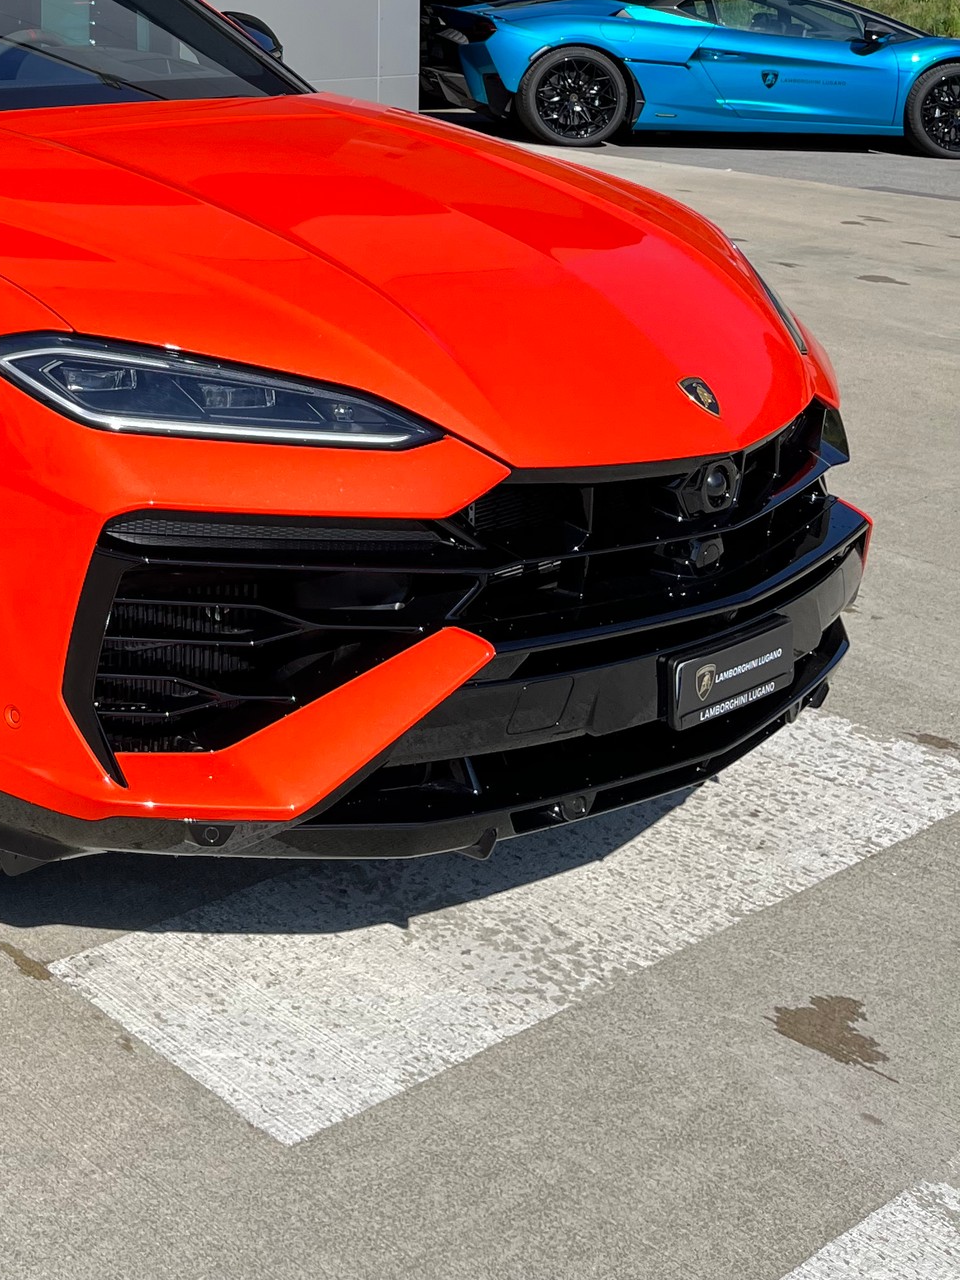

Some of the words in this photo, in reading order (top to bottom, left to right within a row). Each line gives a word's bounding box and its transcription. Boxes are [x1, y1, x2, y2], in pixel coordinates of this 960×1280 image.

[715, 658, 758, 683] LAMBORGHINI
[757, 648, 783, 666] LUGANO
[700, 695, 748, 721] LAMBORGHINI
[748, 682, 775, 701] LUGANO
